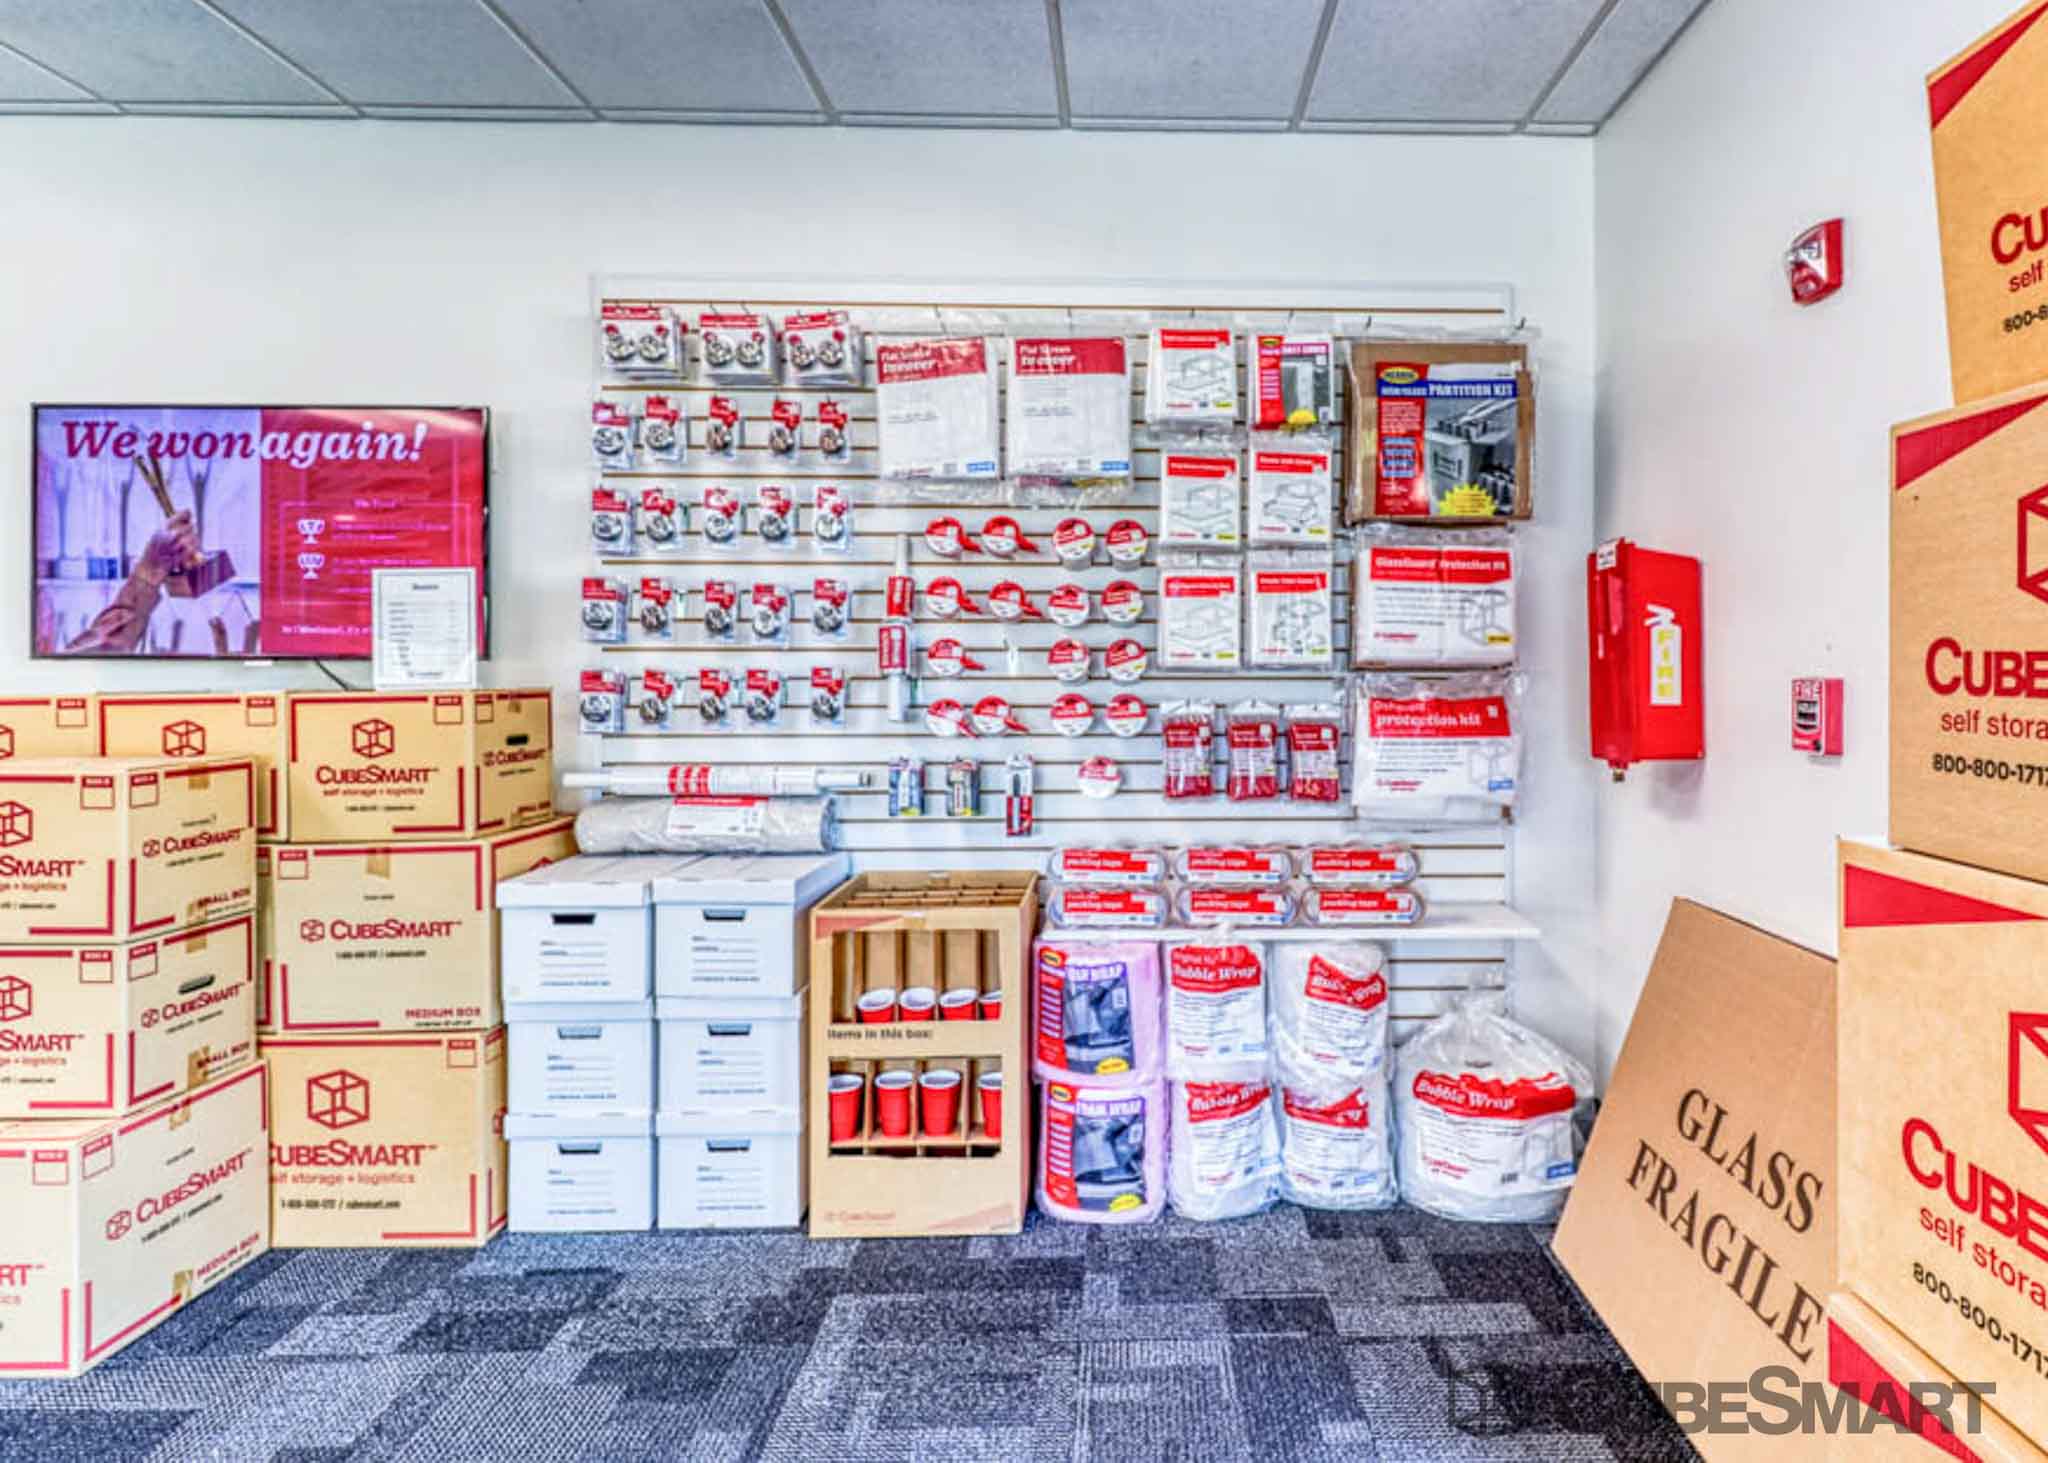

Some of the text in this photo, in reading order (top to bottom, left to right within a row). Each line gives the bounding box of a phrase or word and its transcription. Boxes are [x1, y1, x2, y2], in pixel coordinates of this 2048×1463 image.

[2008, 259, 2043, 293] self
[62, 420, 428, 470] We won again!
[1925, 636, 2048, 699] CUBE
[1376, 713, 1458, 730] protection
[1940, 709, 1980, 734] self
[1676, 1087, 1824, 1234] GLASS
[1902, 1117, 2048, 1264] CUBE
[1625, 1137, 1825, 1364] FRAGILE
[1918, 1205, 1966, 1254] self
